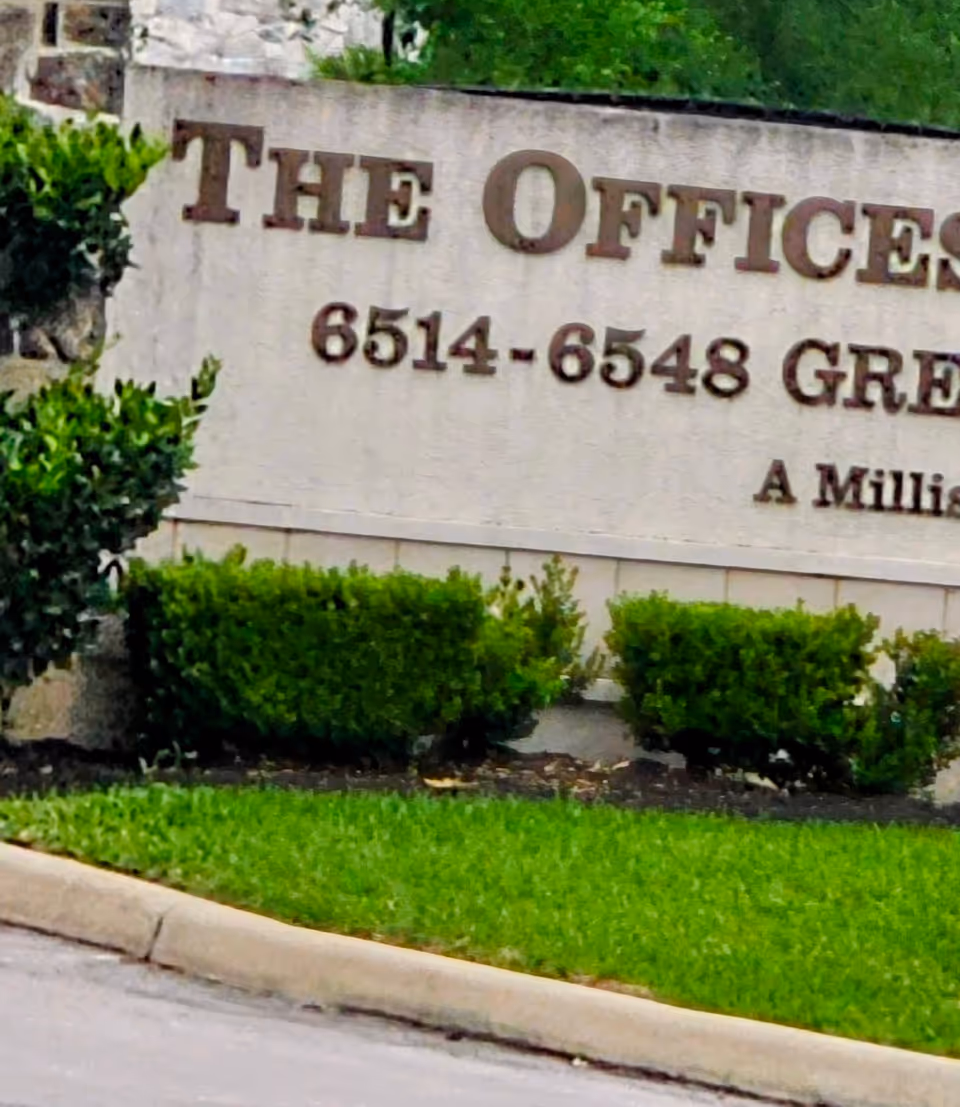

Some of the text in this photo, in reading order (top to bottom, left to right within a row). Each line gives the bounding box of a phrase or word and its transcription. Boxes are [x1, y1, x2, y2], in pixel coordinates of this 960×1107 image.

[172, 119, 433, 242] THE
[311, 302, 749, 398] 6514-6548
[753, 459, 796, 505] A
